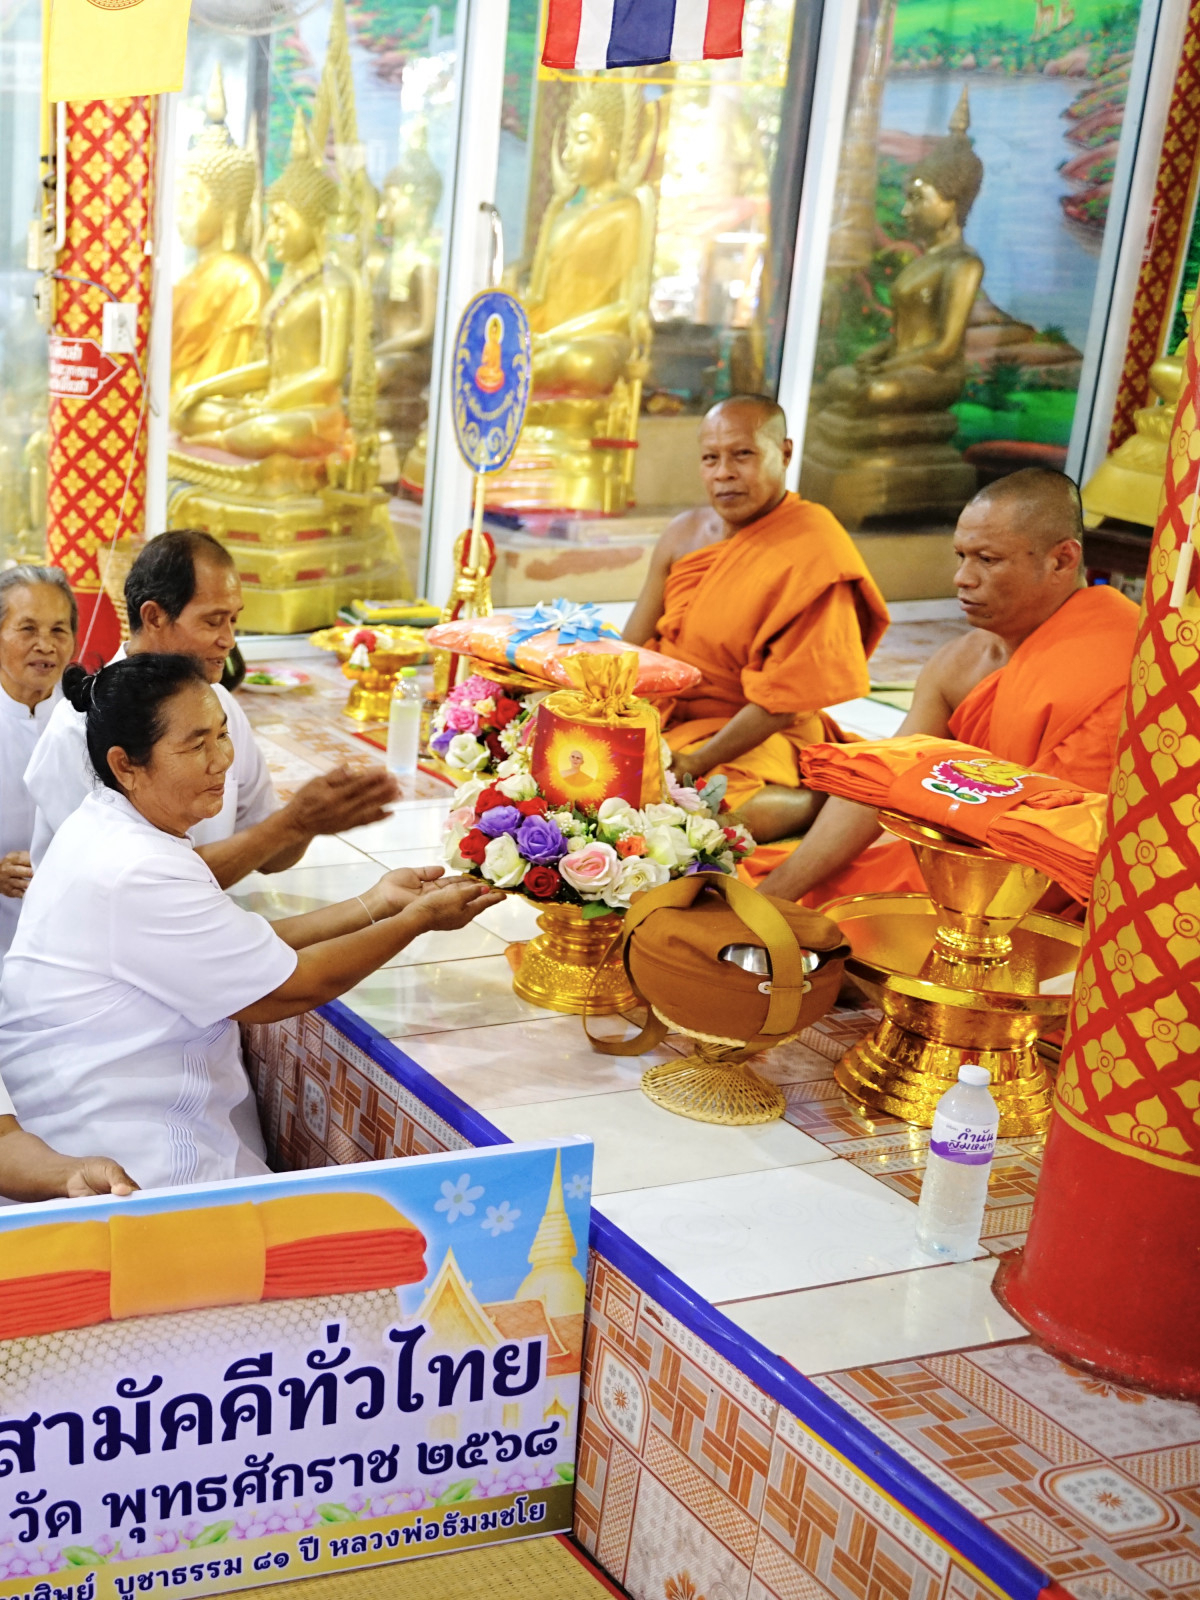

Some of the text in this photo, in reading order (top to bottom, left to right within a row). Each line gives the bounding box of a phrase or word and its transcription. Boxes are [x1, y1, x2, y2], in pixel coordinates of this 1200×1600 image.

[9, 1488, 82, 1543] วัด
[102, 1444, 400, 1544] พุทธศักราช
[417, 1421, 560, 1475] ๒๕๖๘
[114, 1557, 243, 1600] บูชาธรรม
[253, 1551, 290, 1571] ๘๑
[299, 1535, 320, 1562] ปี
[329, 1496, 546, 1557] หลวงพ่อธัมมชโย
